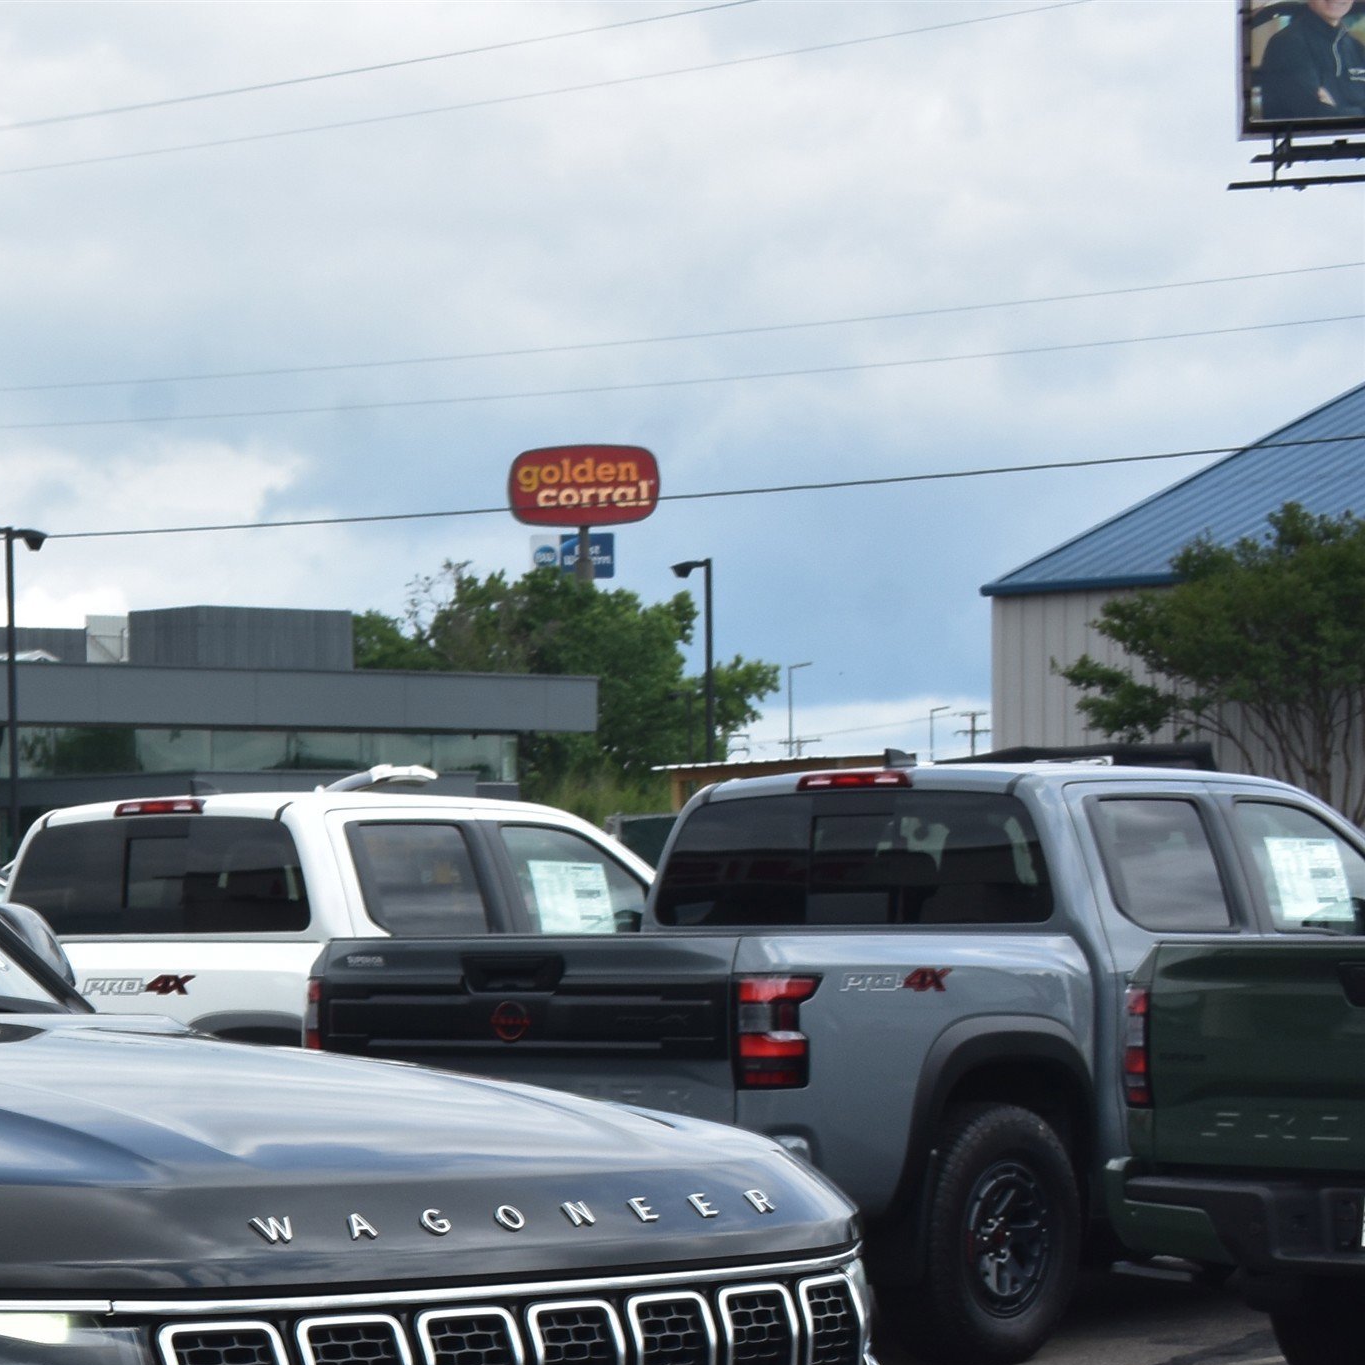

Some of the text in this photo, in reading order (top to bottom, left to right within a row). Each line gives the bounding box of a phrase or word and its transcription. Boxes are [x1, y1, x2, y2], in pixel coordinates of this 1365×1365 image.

[518, 458, 639, 492] golden
[536, 480, 651, 507] corral
[248, 1188, 777, 1244] WAGONEER
